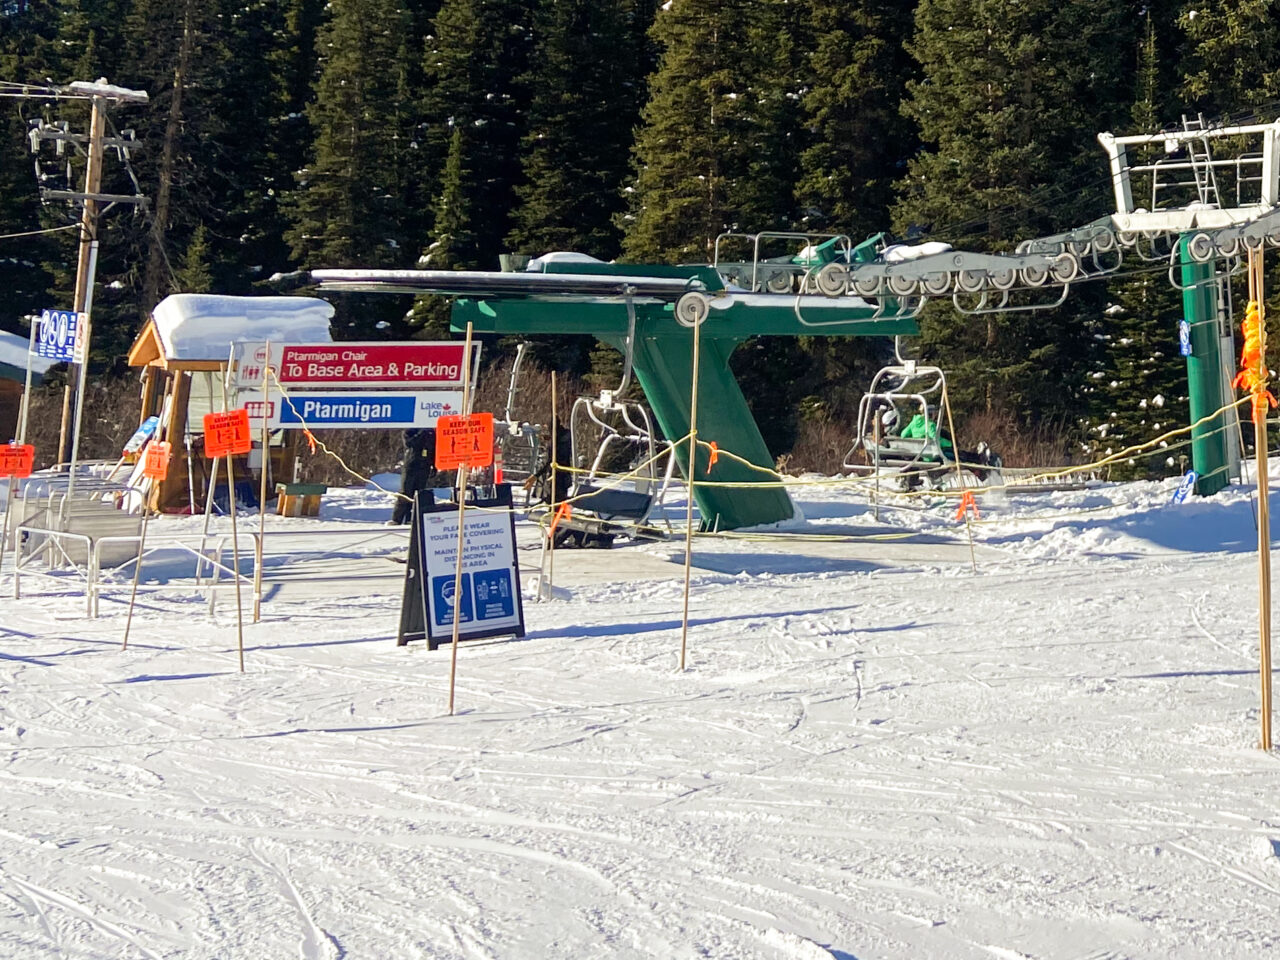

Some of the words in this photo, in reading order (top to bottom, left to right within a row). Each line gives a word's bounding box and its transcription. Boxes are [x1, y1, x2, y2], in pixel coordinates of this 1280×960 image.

[287, 351, 338, 362] Ptarmigan
[342, 350, 367, 361] Chair
[286, 363, 303, 377] To
[308, 363, 344, 377] Base
[347, 363, 383, 377] Area
[387, 362, 399, 376] &
[404, 362, 458, 379] Parking
[303, 400, 392, 421] Ptarmigan
[420, 401, 442, 410] Lake
[443, 524, 468, 532] PLEAE
[469, 528, 504, 537] COVERING
[434, 547, 469, 556] MAINTN
[470, 543, 503, 551] PHYSICAL
